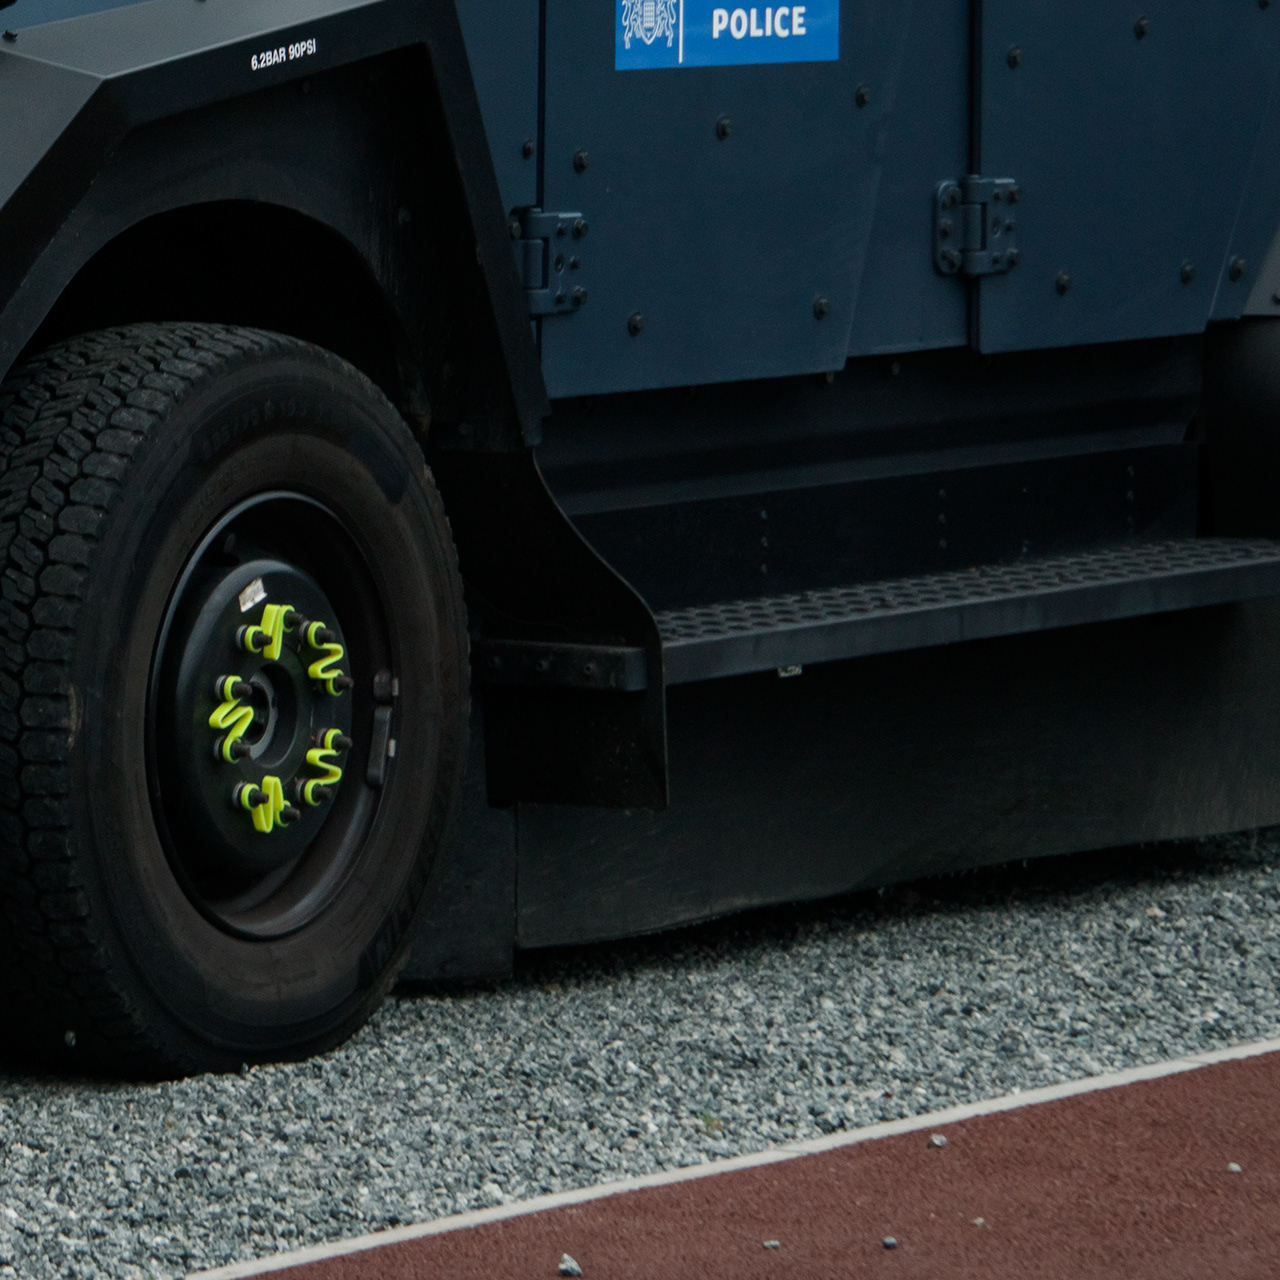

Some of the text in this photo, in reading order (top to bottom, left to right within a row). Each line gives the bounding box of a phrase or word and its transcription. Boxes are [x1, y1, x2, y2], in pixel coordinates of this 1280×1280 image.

[712, 5, 807, 40] POLICE
[251, 37, 317, 71] 6.2BAR 90PSI
